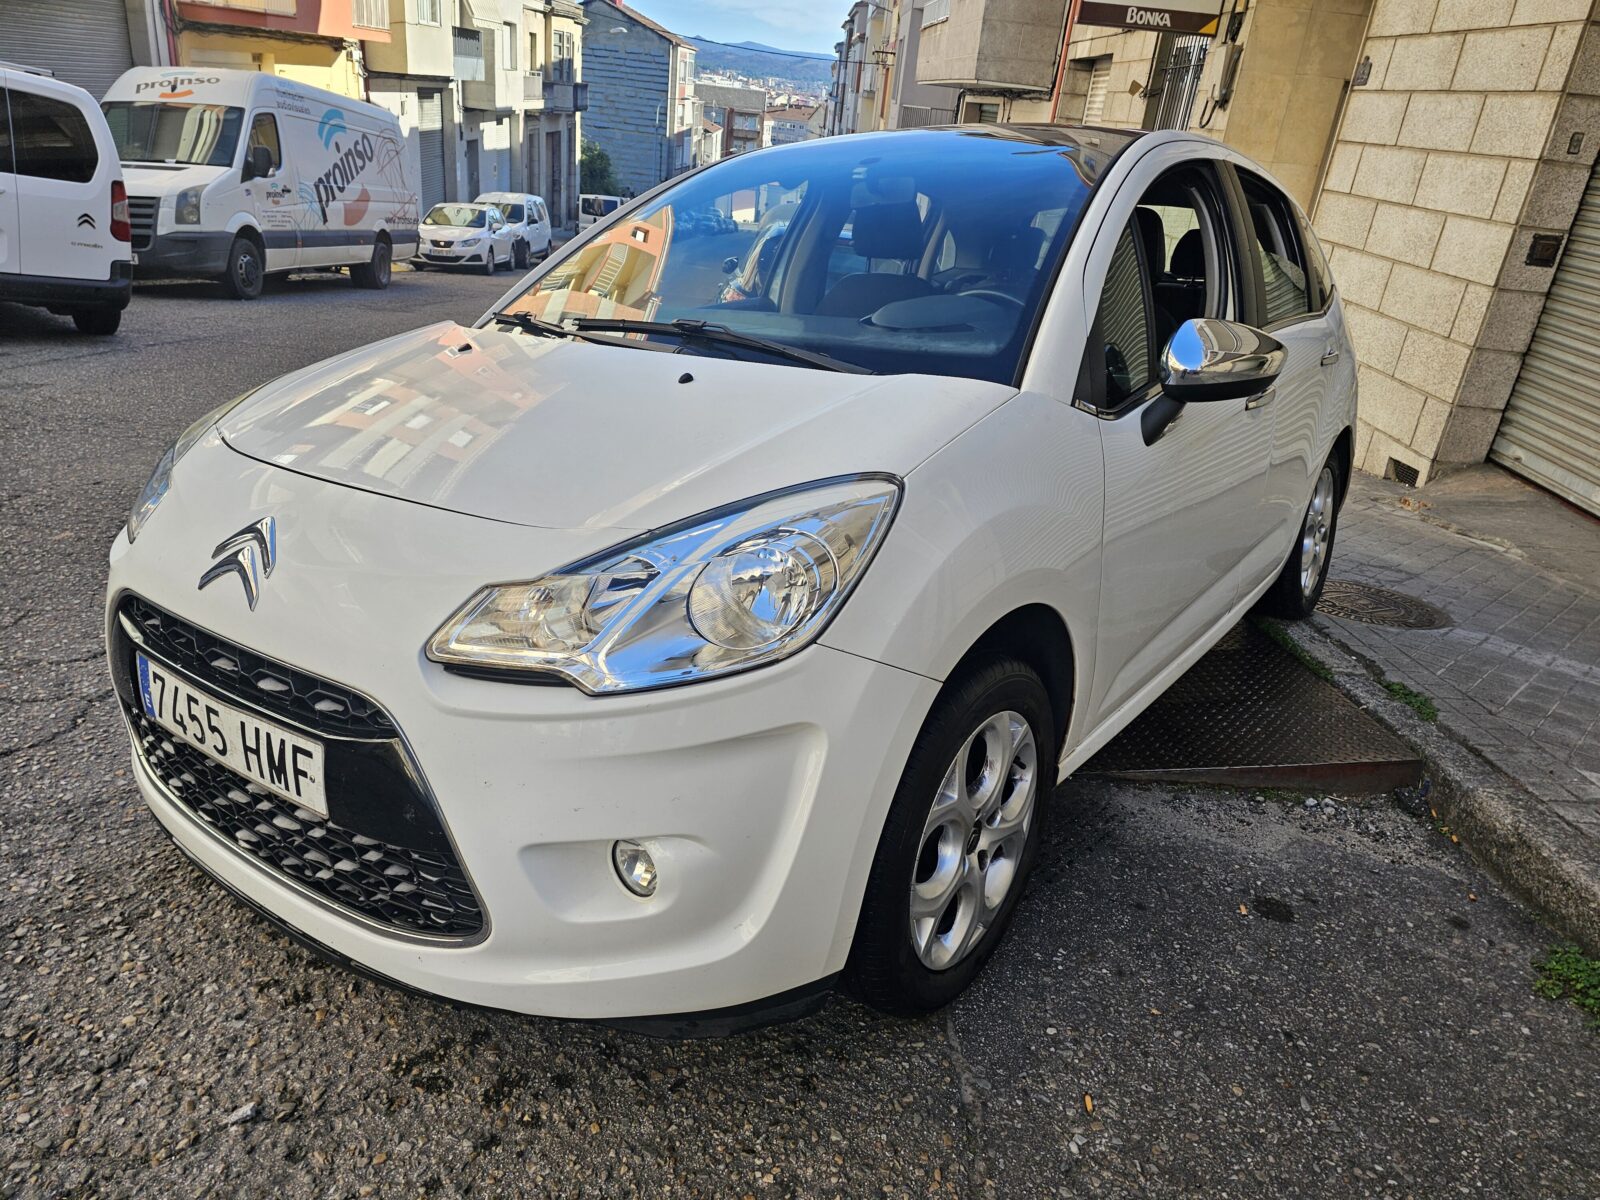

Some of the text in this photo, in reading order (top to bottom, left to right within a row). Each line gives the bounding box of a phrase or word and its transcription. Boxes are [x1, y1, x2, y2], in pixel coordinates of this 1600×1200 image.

[1126, 7, 1171, 27] BONKA
[135, 77, 221, 94] proinso
[313, 133, 374, 225] proinso
[152, 670, 314, 798] 7455 HMF
